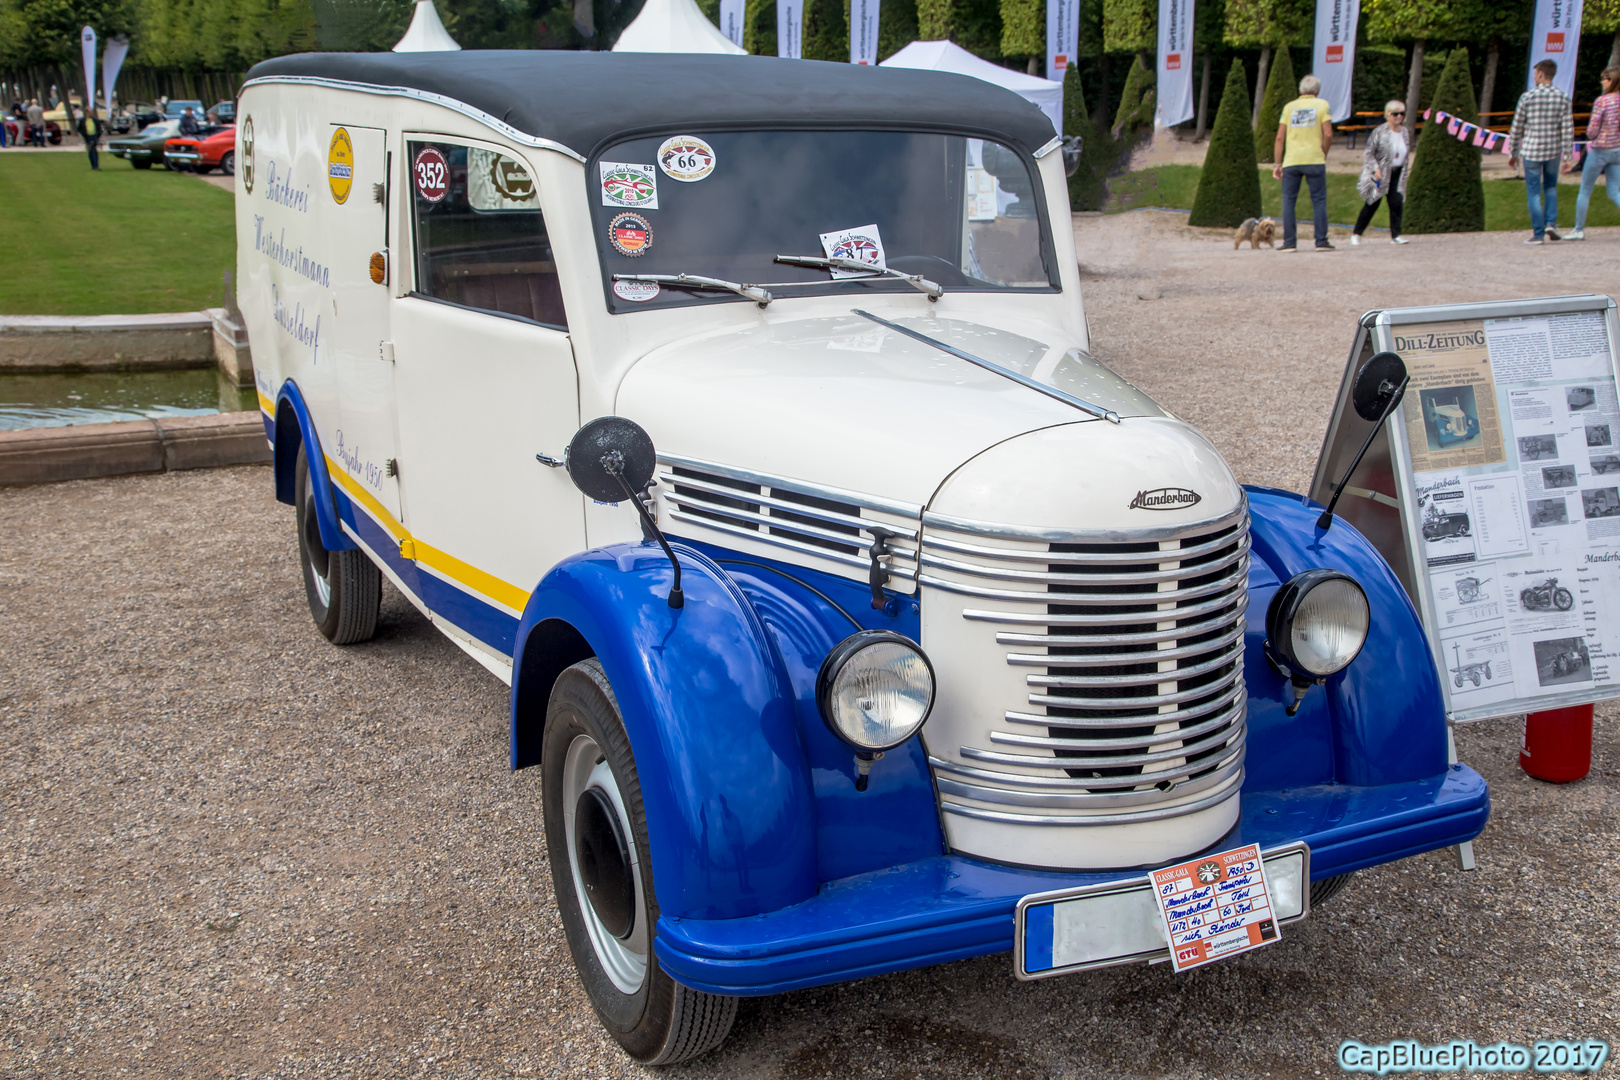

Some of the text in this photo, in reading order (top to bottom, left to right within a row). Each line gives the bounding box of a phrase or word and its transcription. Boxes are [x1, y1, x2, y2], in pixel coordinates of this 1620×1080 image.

[678, 154, 696, 168] 66
[418, 162, 445, 189] 352
[265, 160, 310, 213] Bäckerei
[615, 217, 624, 226] MADE
[630, 216, 648, 230] GERMANY
[846, 246, 863, 259] 87
[365, 460, 383, 491] 1950
[1416, 475, 1460, 496] Manderbach
[1223, 848, 1257, 864] SCHWETZINGEN
[1156, 868, 1189, 883] CLASSIC-GALA
[1228, 866, 1244, 877] 1950
[1162, 884, 1174, 894] 87
[1223, 906, 1232, 916] 60
[1213, 934, 1249, 949] württembergische
[1179, 946, 1198, 960] GTÜ
